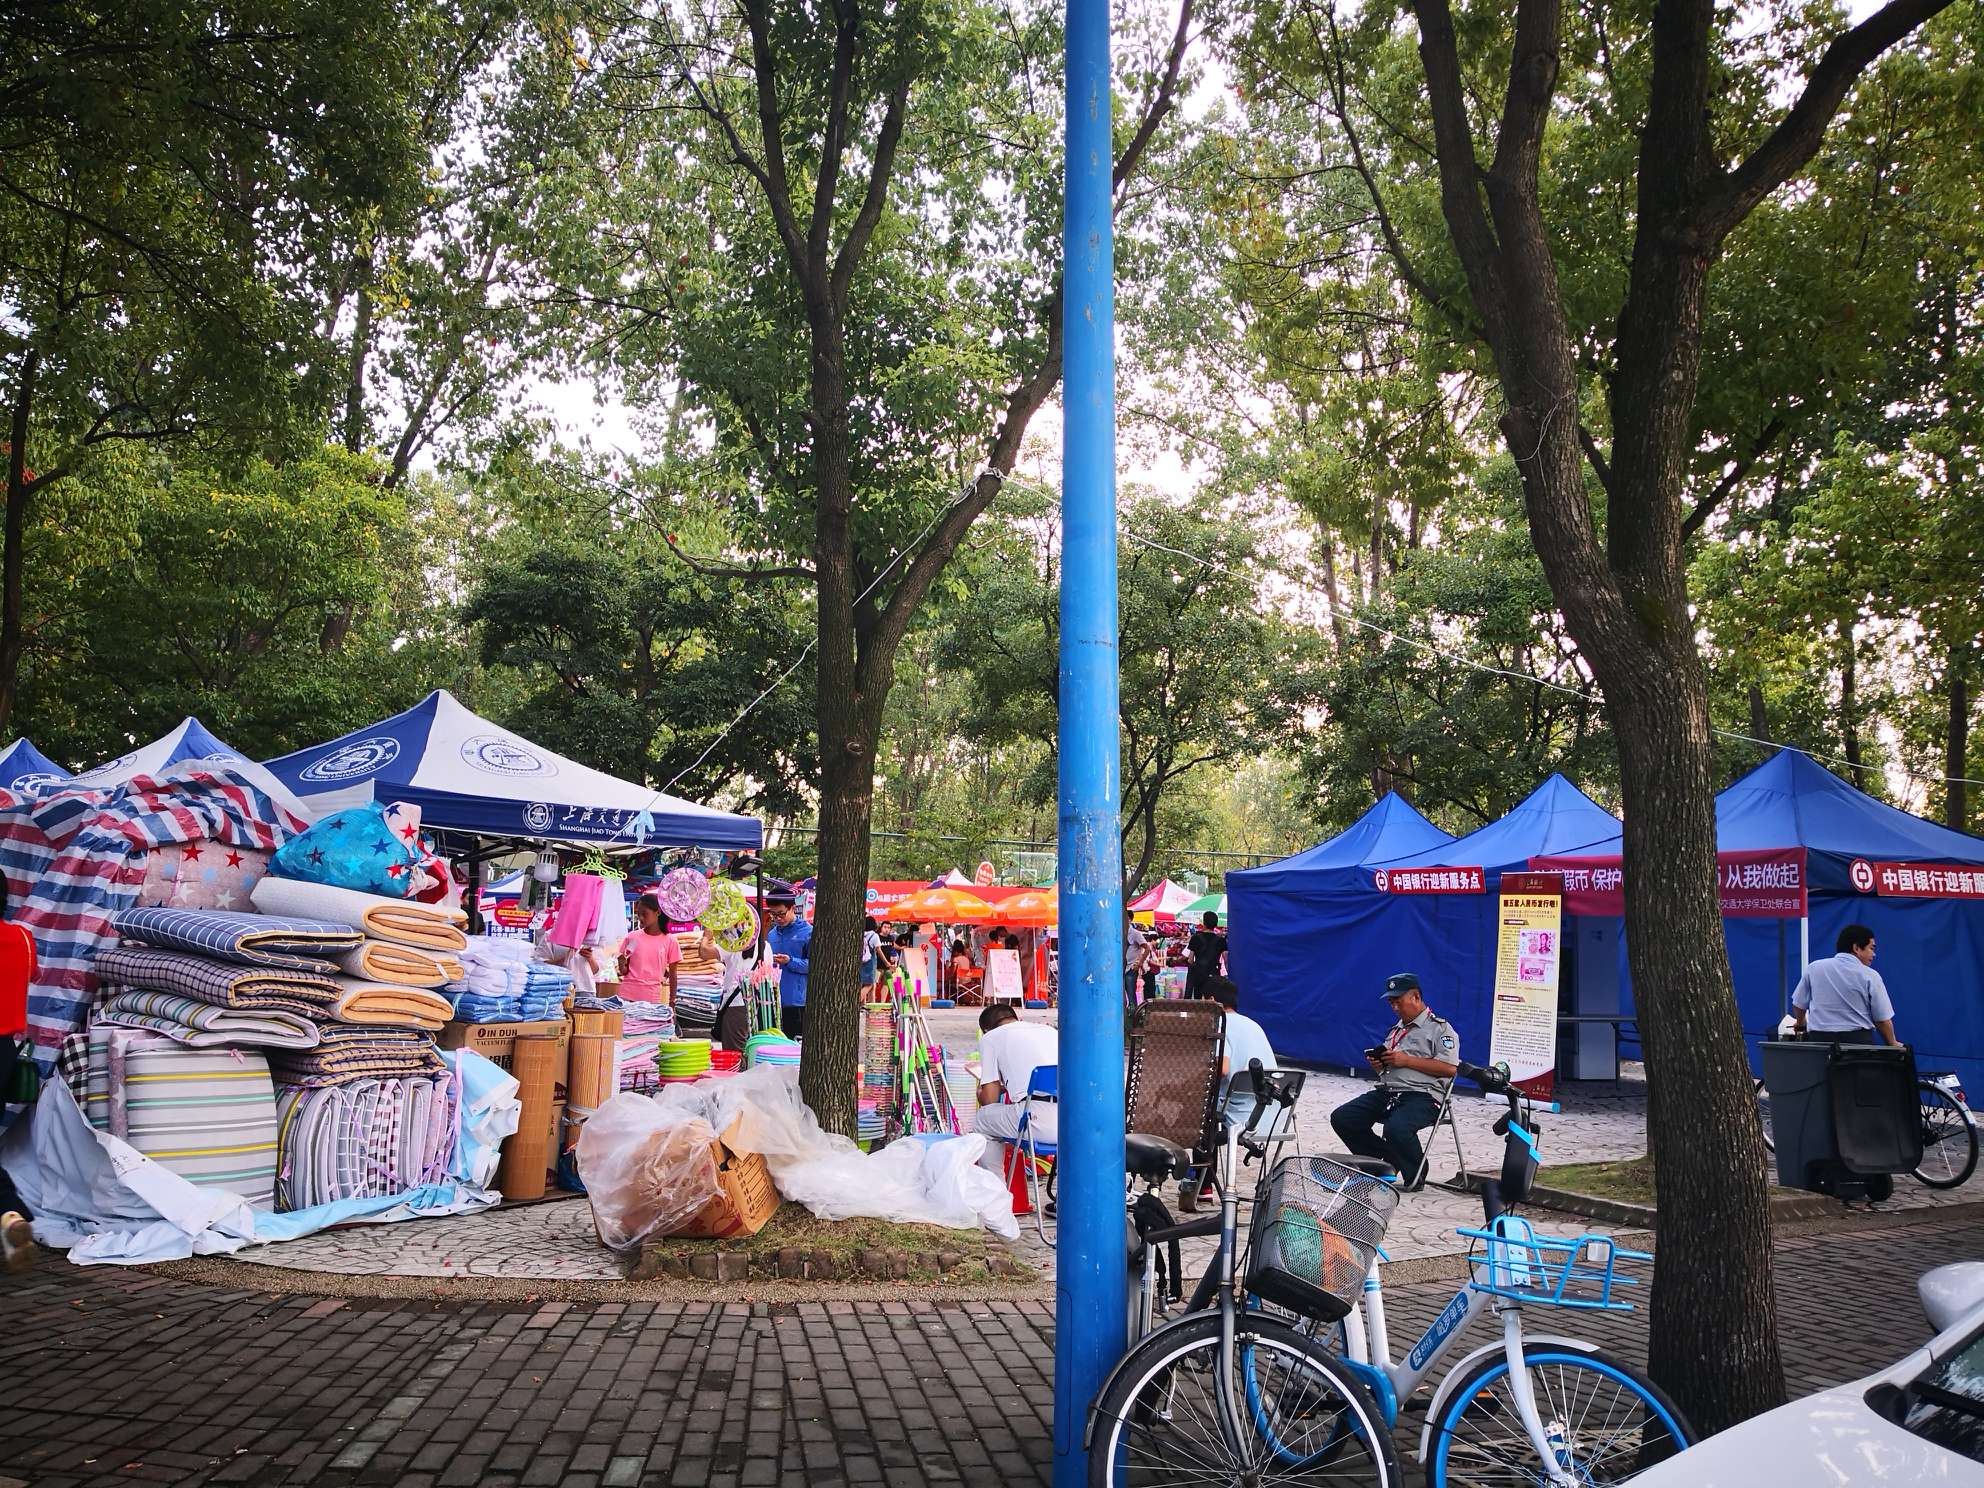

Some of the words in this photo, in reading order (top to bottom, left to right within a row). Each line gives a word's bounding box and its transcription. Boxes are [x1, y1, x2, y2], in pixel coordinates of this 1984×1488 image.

[559, 824, 591, 834] SHANGHAI
[1393, 871, 1481, 891] 中国银行迎新服务点
[1725, 862, 1800, 889] 从我做起
